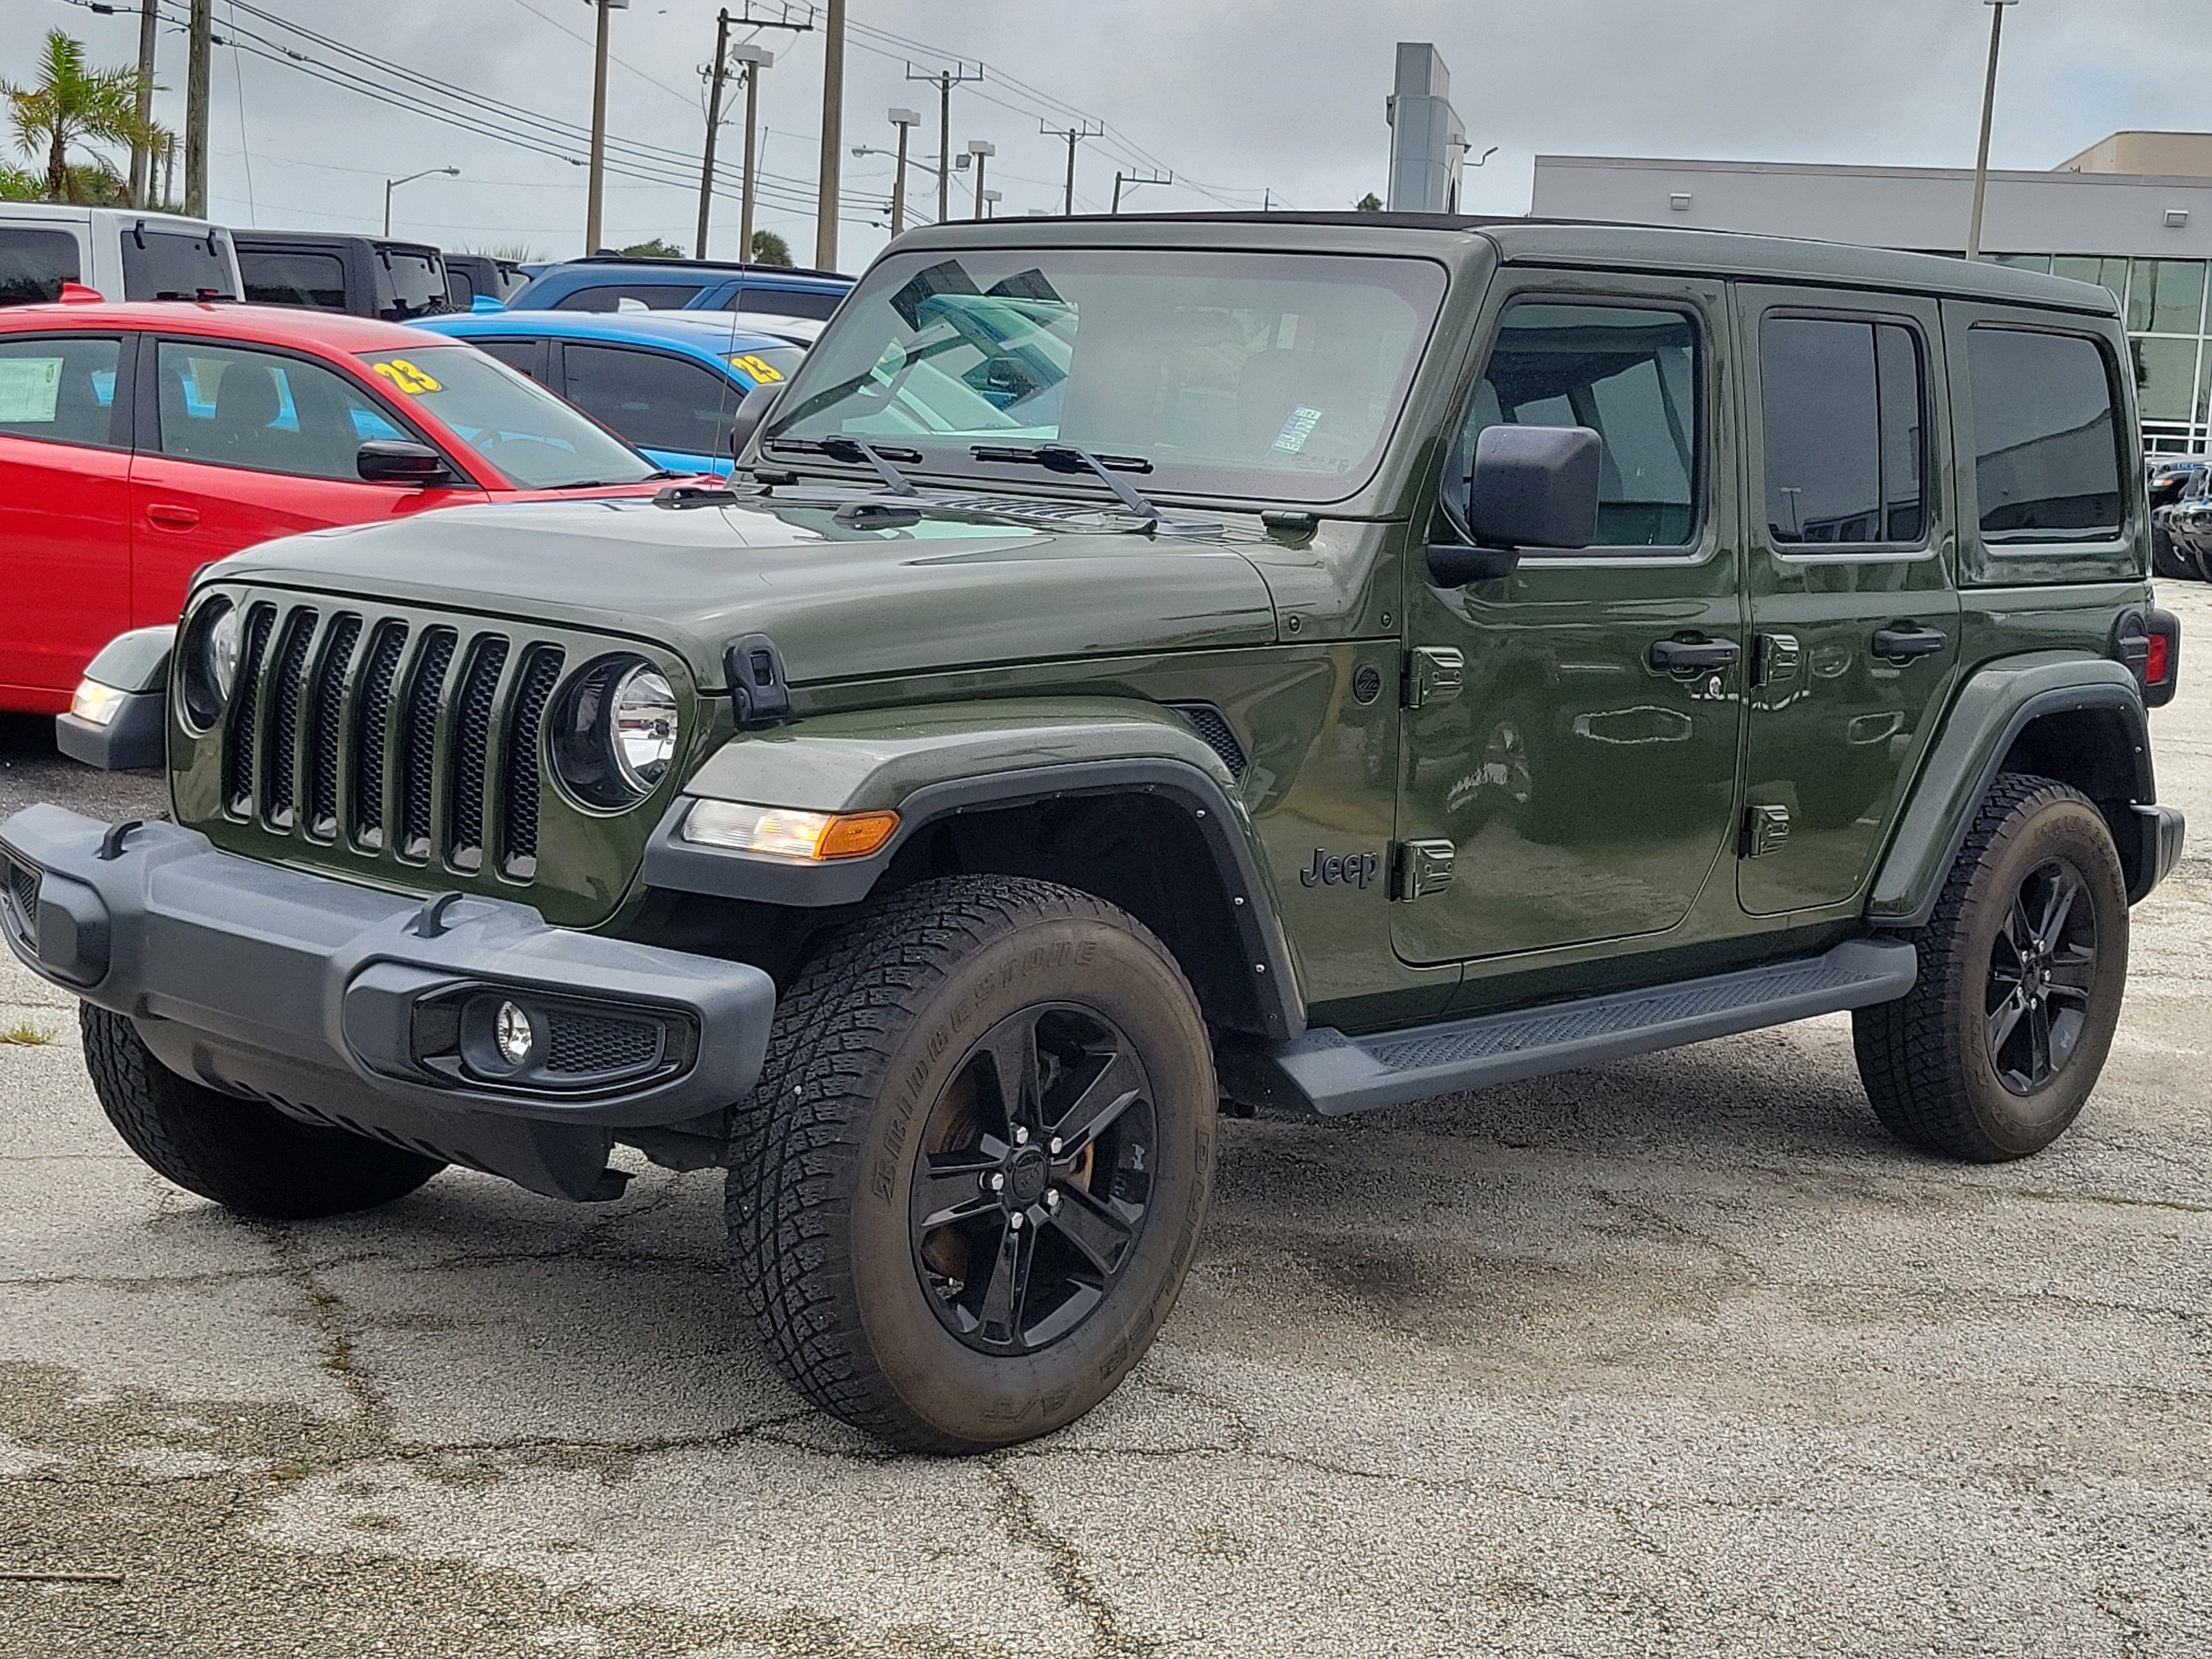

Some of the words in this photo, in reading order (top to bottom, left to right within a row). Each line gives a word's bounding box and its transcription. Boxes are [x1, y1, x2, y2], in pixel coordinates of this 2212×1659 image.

[374, 360, 443, 394] 23
[731, 355, 785, 383] 23
[1300, 847, 1380, 889] Jeep
[2034, 815, 2127, 913] BRIDGES
[872, 938, 1098, 1204] BRIDGESTONE
[1099, 1128, 1212, 1383] DUELER
